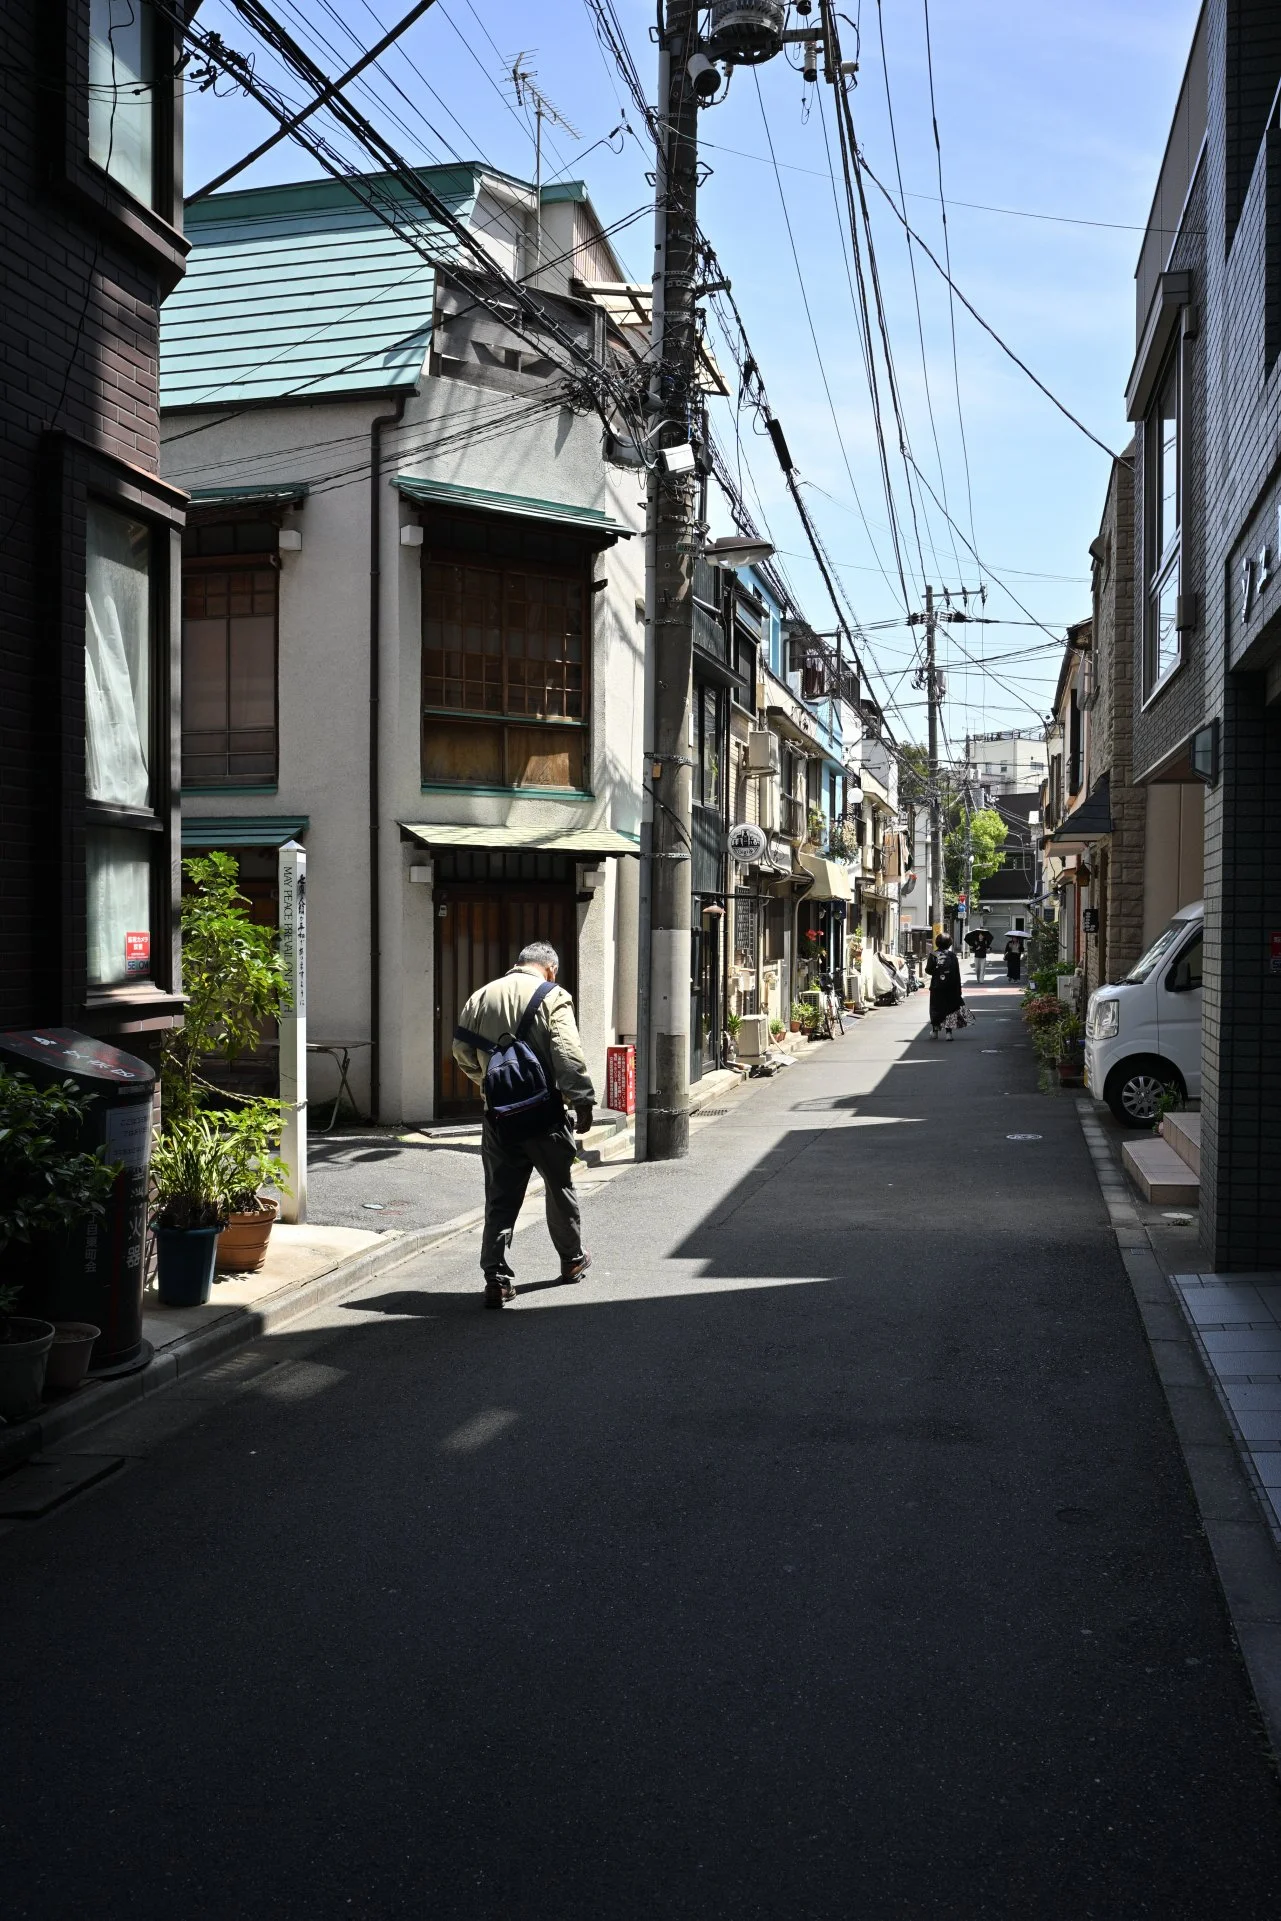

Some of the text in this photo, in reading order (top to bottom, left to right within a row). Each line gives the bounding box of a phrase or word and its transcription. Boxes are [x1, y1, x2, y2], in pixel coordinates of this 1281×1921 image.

[127, 960, 149, 970] SEOM
[283, 866, 293, 1013] MAY PEACE PREVAIL ON EAH
